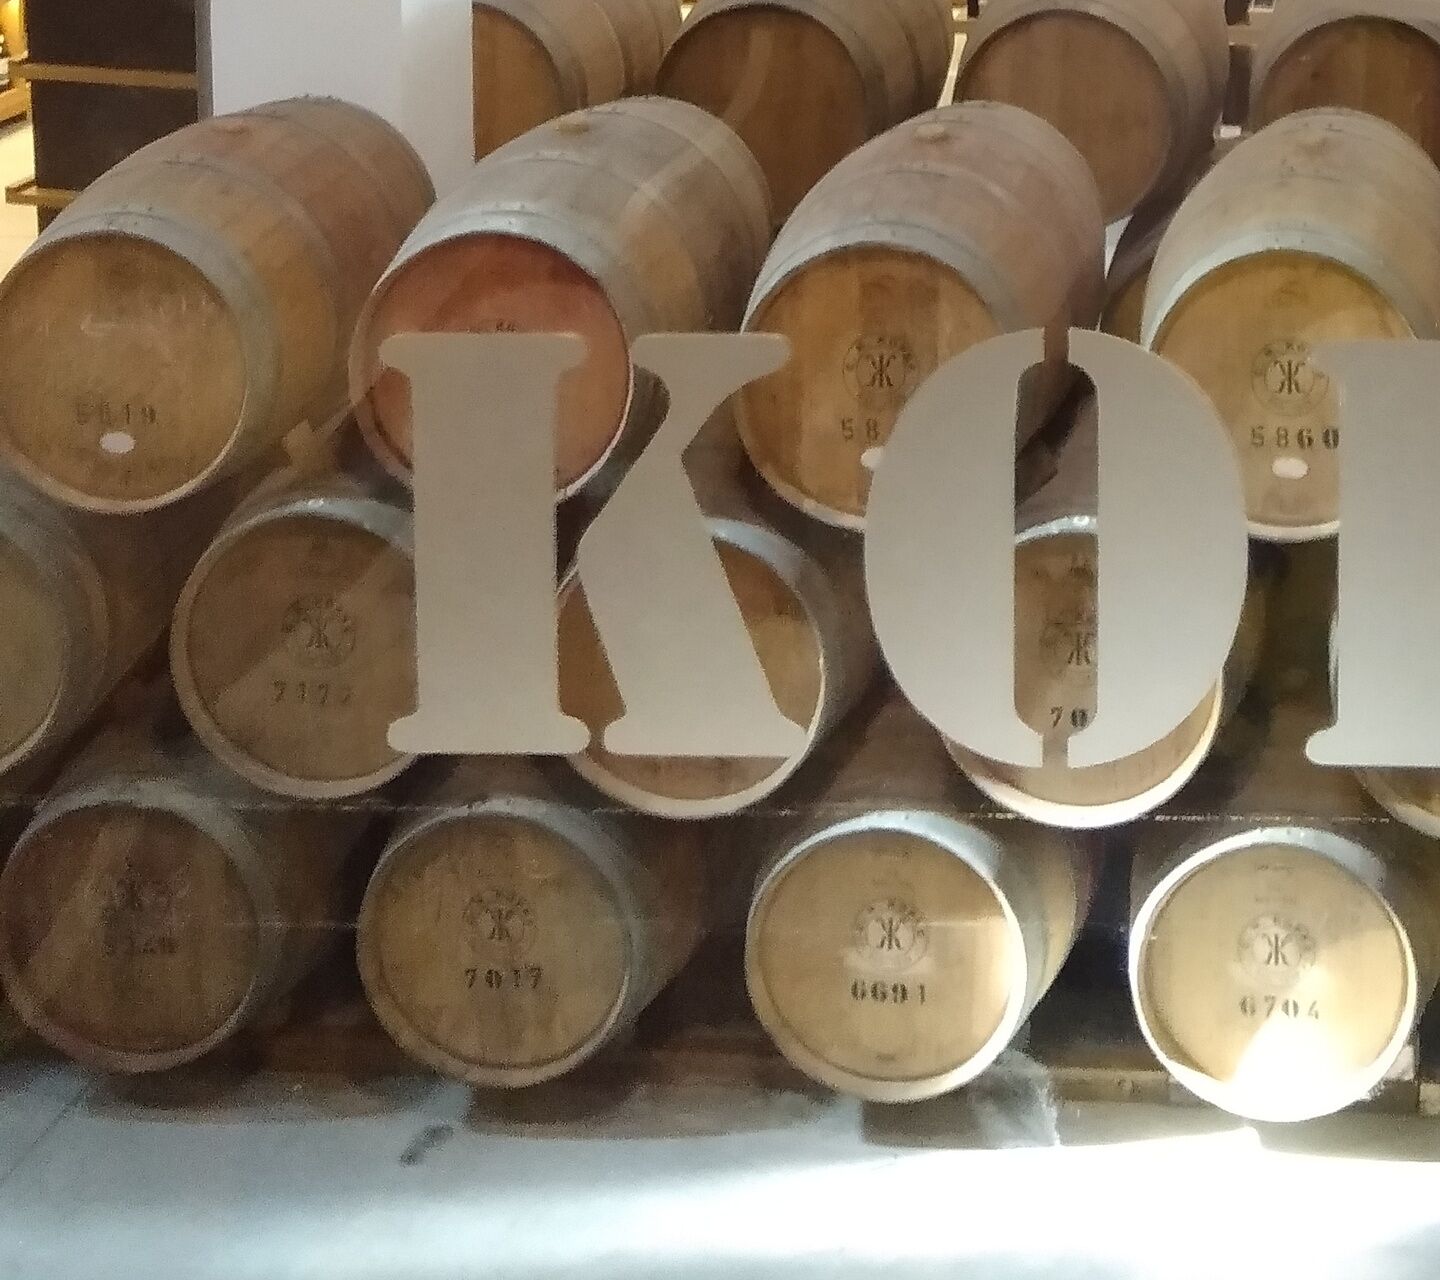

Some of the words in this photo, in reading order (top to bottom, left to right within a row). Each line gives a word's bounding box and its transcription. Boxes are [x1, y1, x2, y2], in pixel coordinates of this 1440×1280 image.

[464, 966, 542, 990] 7017
[851, 980, 926, 1005] 6691
[1238, 994, 1320, 1020] 6704
